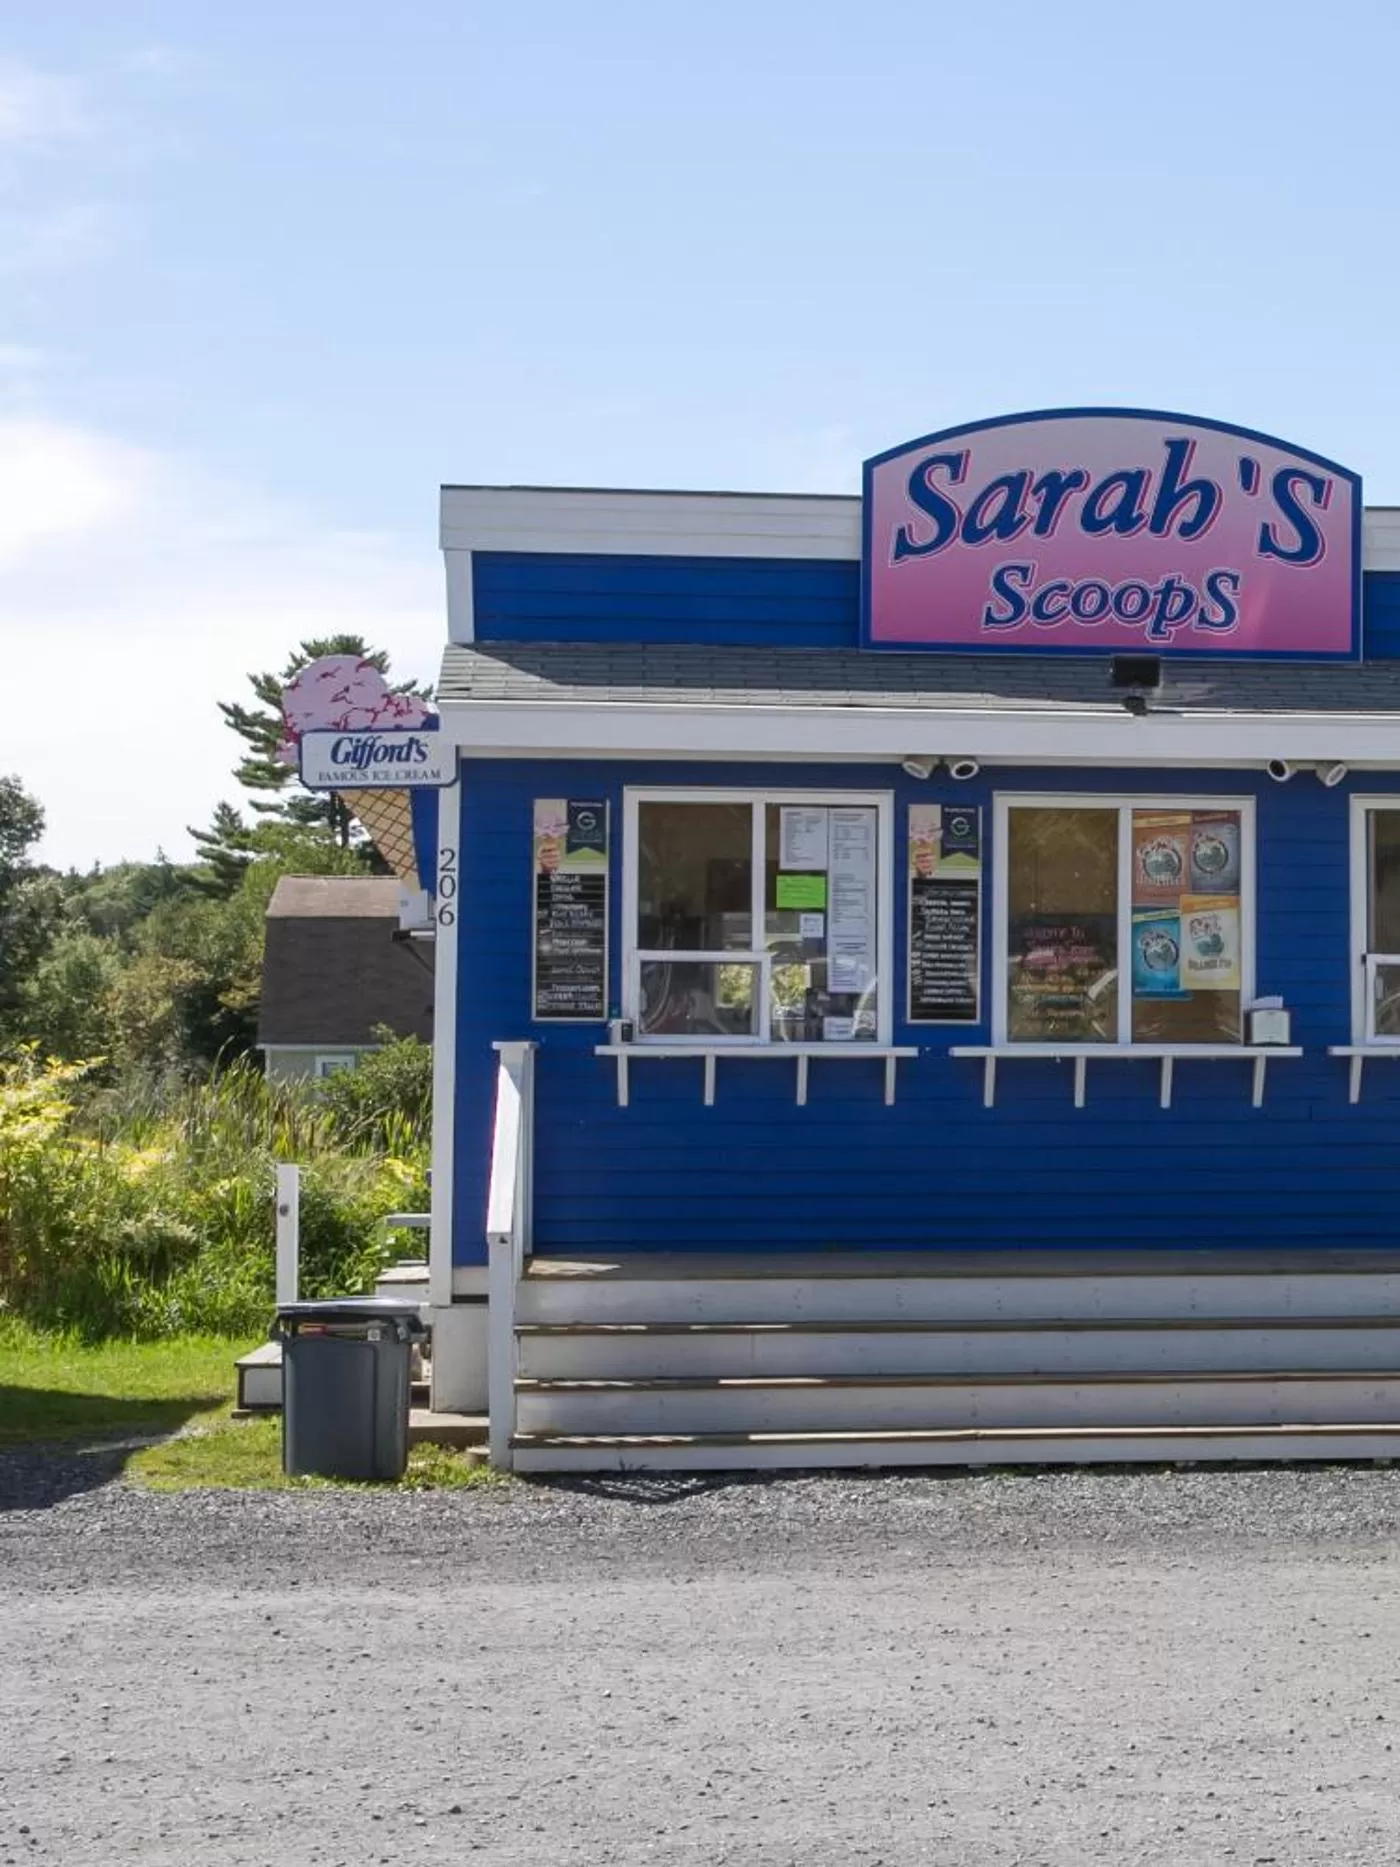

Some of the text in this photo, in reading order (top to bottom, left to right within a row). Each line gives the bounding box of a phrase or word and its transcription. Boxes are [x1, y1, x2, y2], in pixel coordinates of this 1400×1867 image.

[330, 735, 429, 770] Gifford's
[318, 768, 442, 782] FAMOUS ICE CREAM
[438, 847, 457, 927] 206
